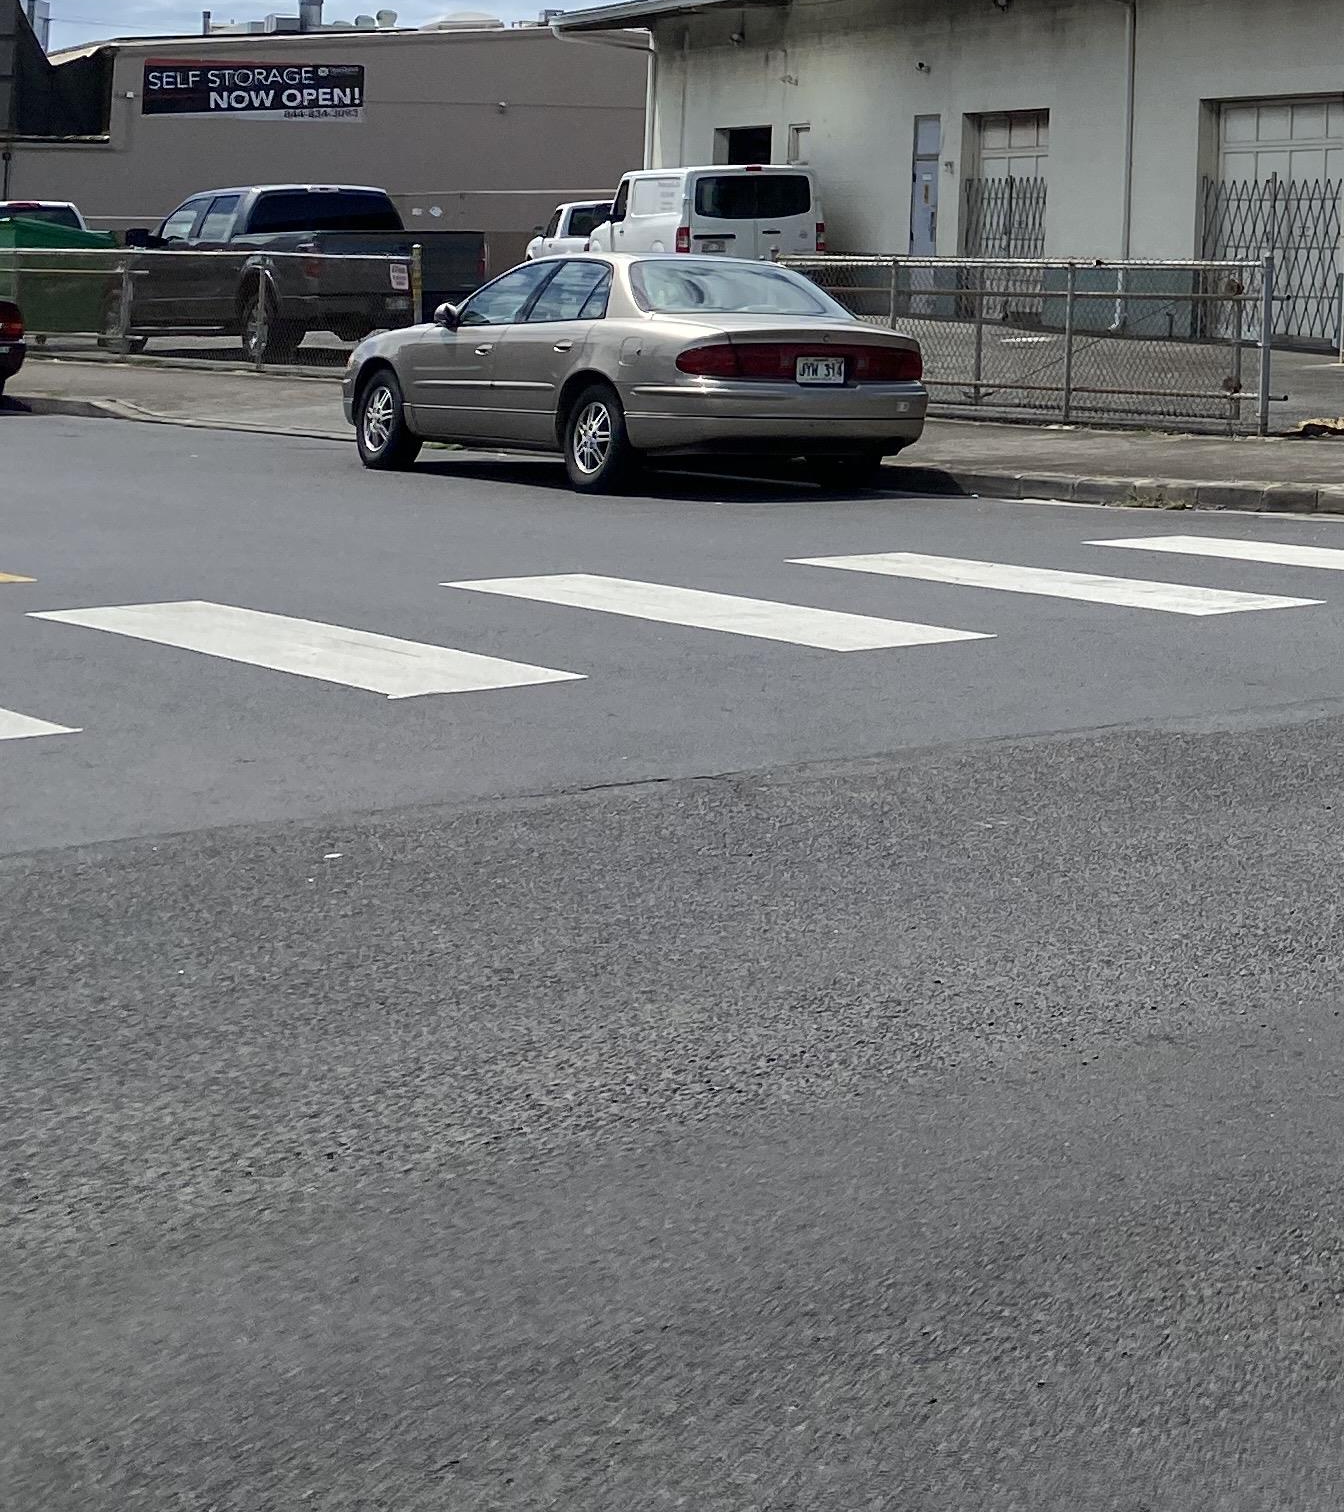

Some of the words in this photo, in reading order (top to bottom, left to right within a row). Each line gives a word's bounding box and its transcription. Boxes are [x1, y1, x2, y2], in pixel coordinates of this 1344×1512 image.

[149, 72, 201, 89] SELF
[207, 67, 316, 88] STORAGE
[209, 90, 275, 109] NOW
[281, 87, 360, 107] OPEN!
